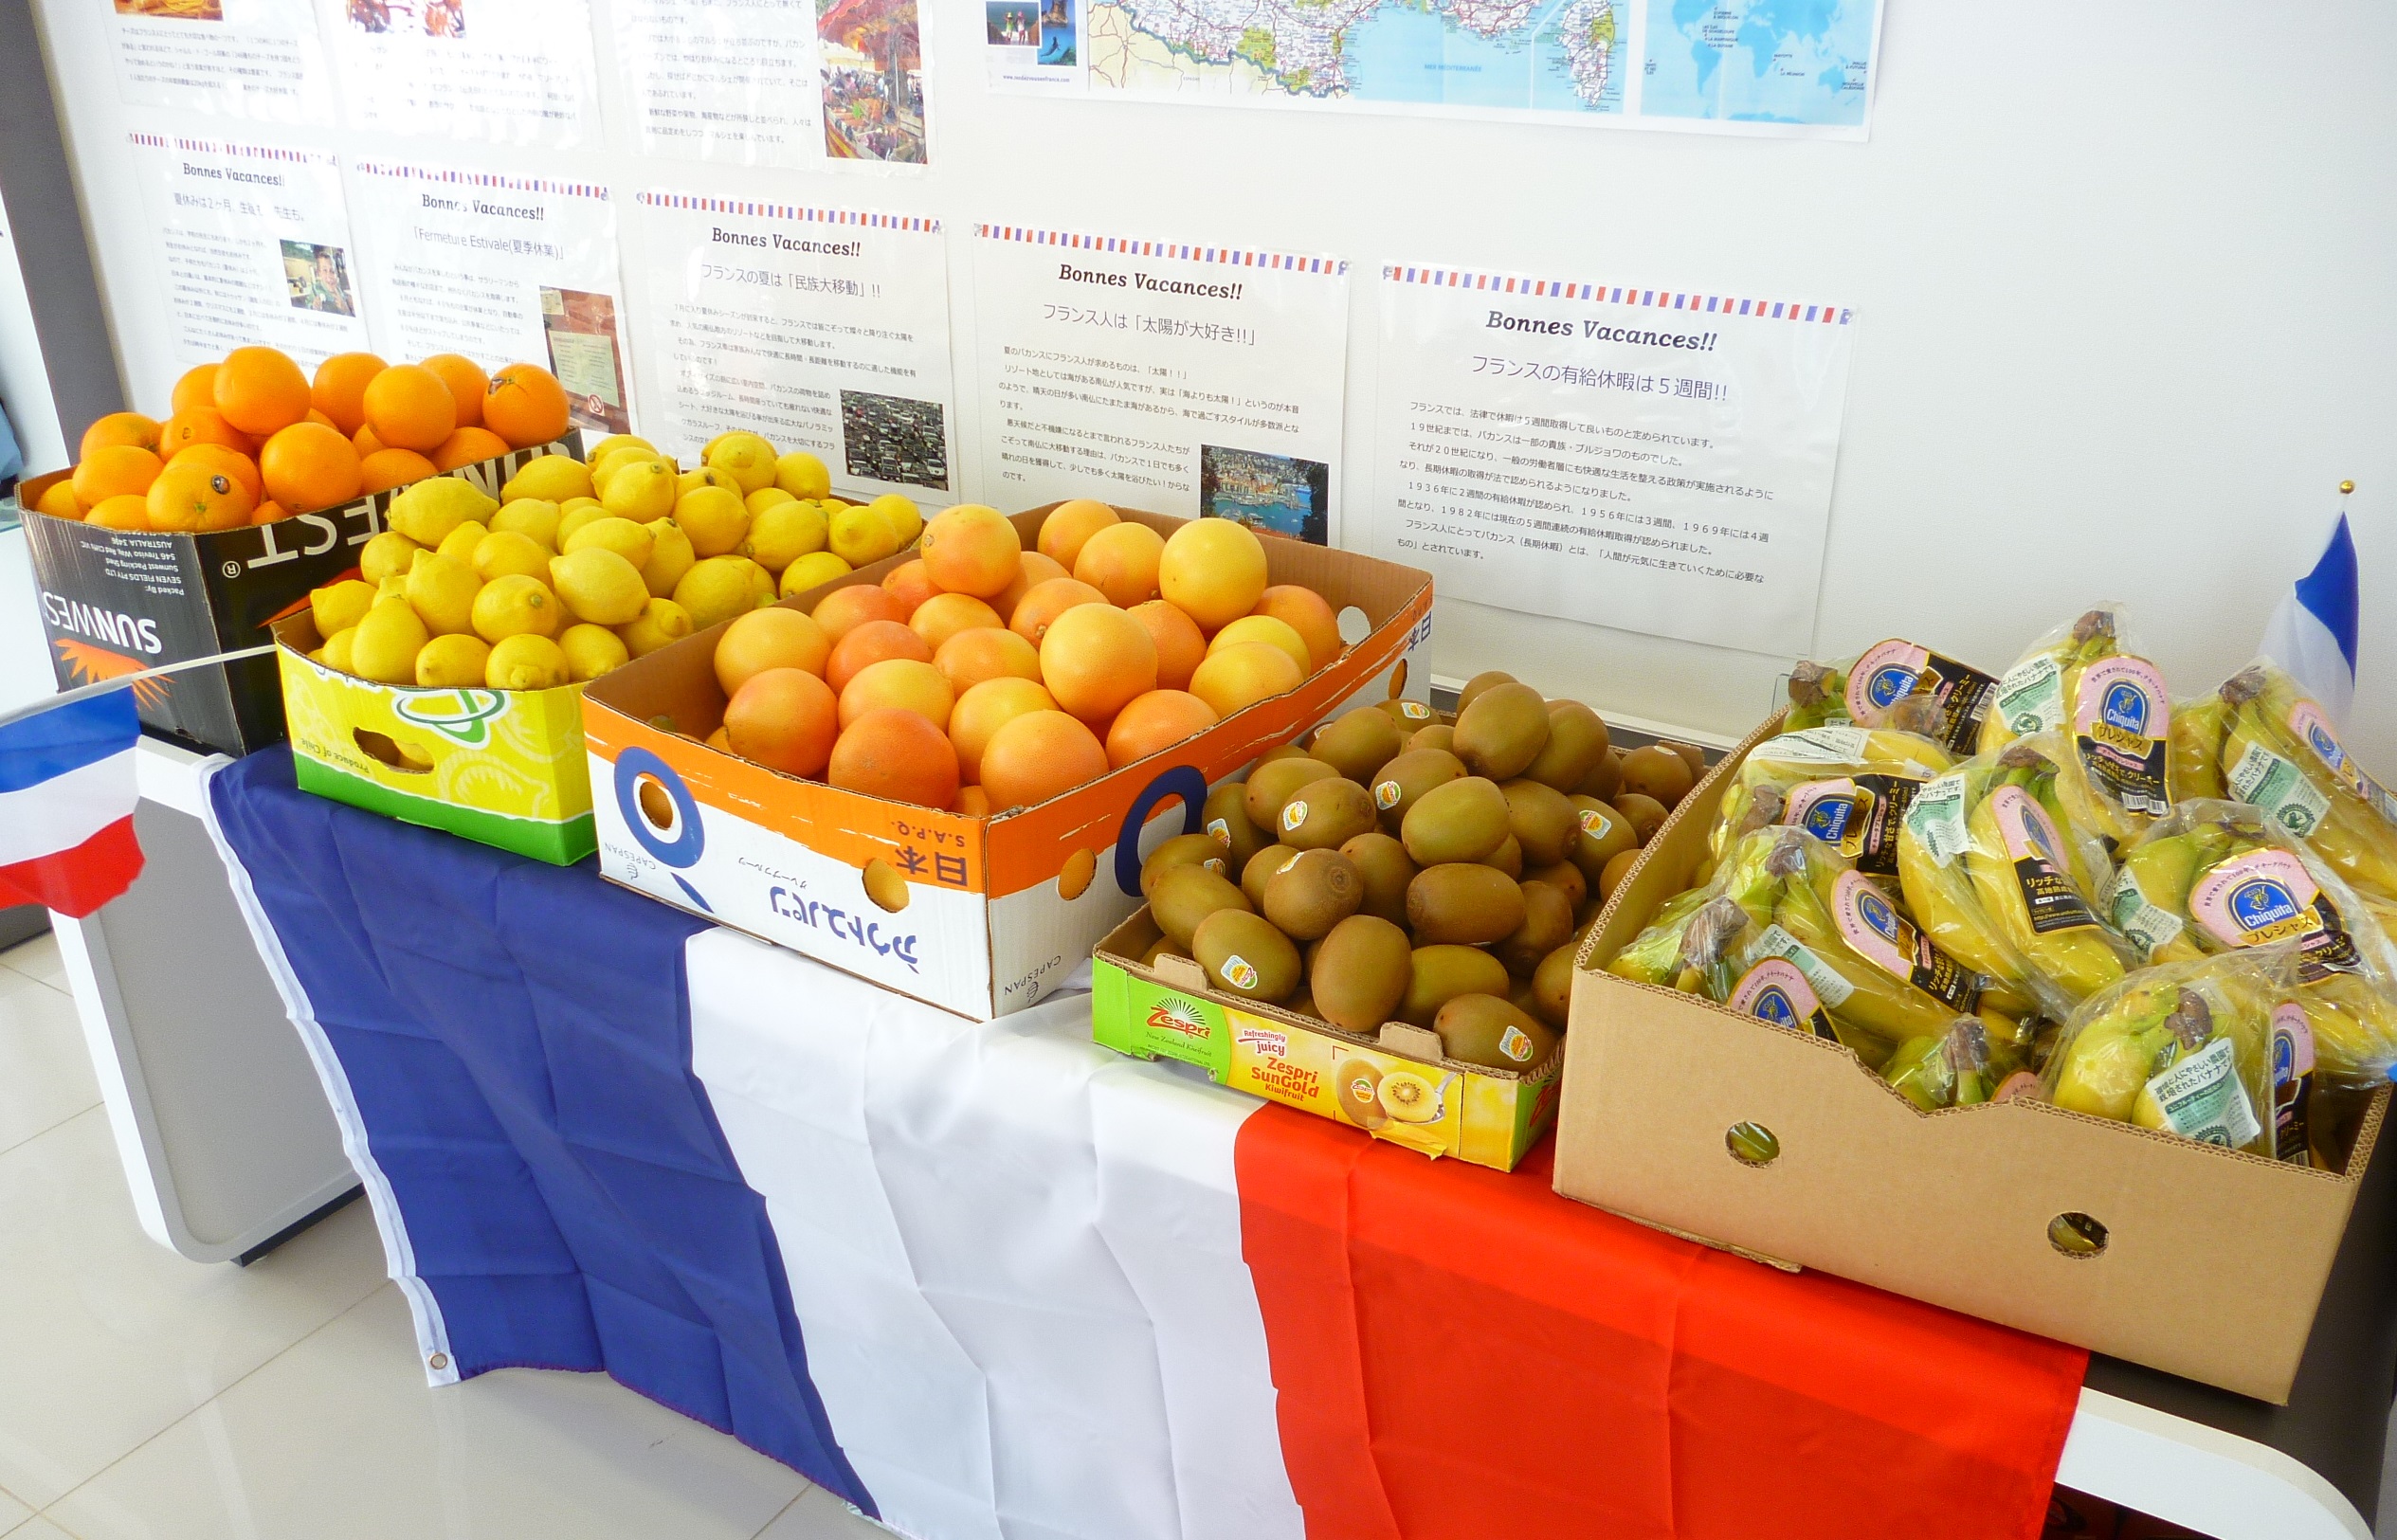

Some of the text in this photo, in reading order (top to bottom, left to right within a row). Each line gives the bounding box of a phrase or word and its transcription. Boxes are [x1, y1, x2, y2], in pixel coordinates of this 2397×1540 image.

[183, 162, 223, 179] Bonnes
[472, 200, 544, 221] Vacances!!
[712, 227, 862, 257] Bonnes Vacances!!
[1058, 263, 1244, 300] Bonnes Vacances!!
[1044, 303, 1257, 346] フランス人は「太陽が大好き!!」
[1486, 310, 1718, 353] Bonnes Vacances!!
[1471, 353, 1729, 402] フランスの有給休暇は５週間!!
[1000, 400, 1024, 411] ります。
[1002, 471, 1026, 482] のです。
[130, 540, 173, 549] AUSTRALIA
[134, 551, 160, 560] Treviso
[159, 553, 176, 561] 546
[1397, 537, 1484, 560] もの」とされています。
[105, 557, 179, 572] Sunwest Packing Shed
[105, 569, 182, 584] SEVEN FIELDS PTY LTD
[144, 586, 185, 596] Packed By:
[2106, 708, 2140, 732] Chiquita
[2098, 724, 2143, 752] プレシャス
[301, 737, 371, 774] Produce of Chile
[890, 820, 966, 848] S.A.P.Q.
[1825, 802, 1848, 841] Chiquita
[604, 842, 656, 870] CAPESPAN
[895, 845, 969, 887] 日本
[737, 856, 808, 890] グレープフルーツ
[2243, 903, 2295, 928] Chiquita
[2246, 915, 2315, 944] プレシャス
[1005, 955, 1062, 995] CAPESPAN
[1147, 1006, 1211, 1040] Zespri
[1244, 1029, 1286, 1042] Refreshingly
[1146, 1031, 1212, 1058] New Zealand Kiwifruit
[1256, 1041, 1285, 1057] juicy
[1251, 1066, 1320, 1098] SunGold
[1267, 1057, 1318, 1084] Zespri
[1264, 1083, 1305, 1102] Kiwifruit
